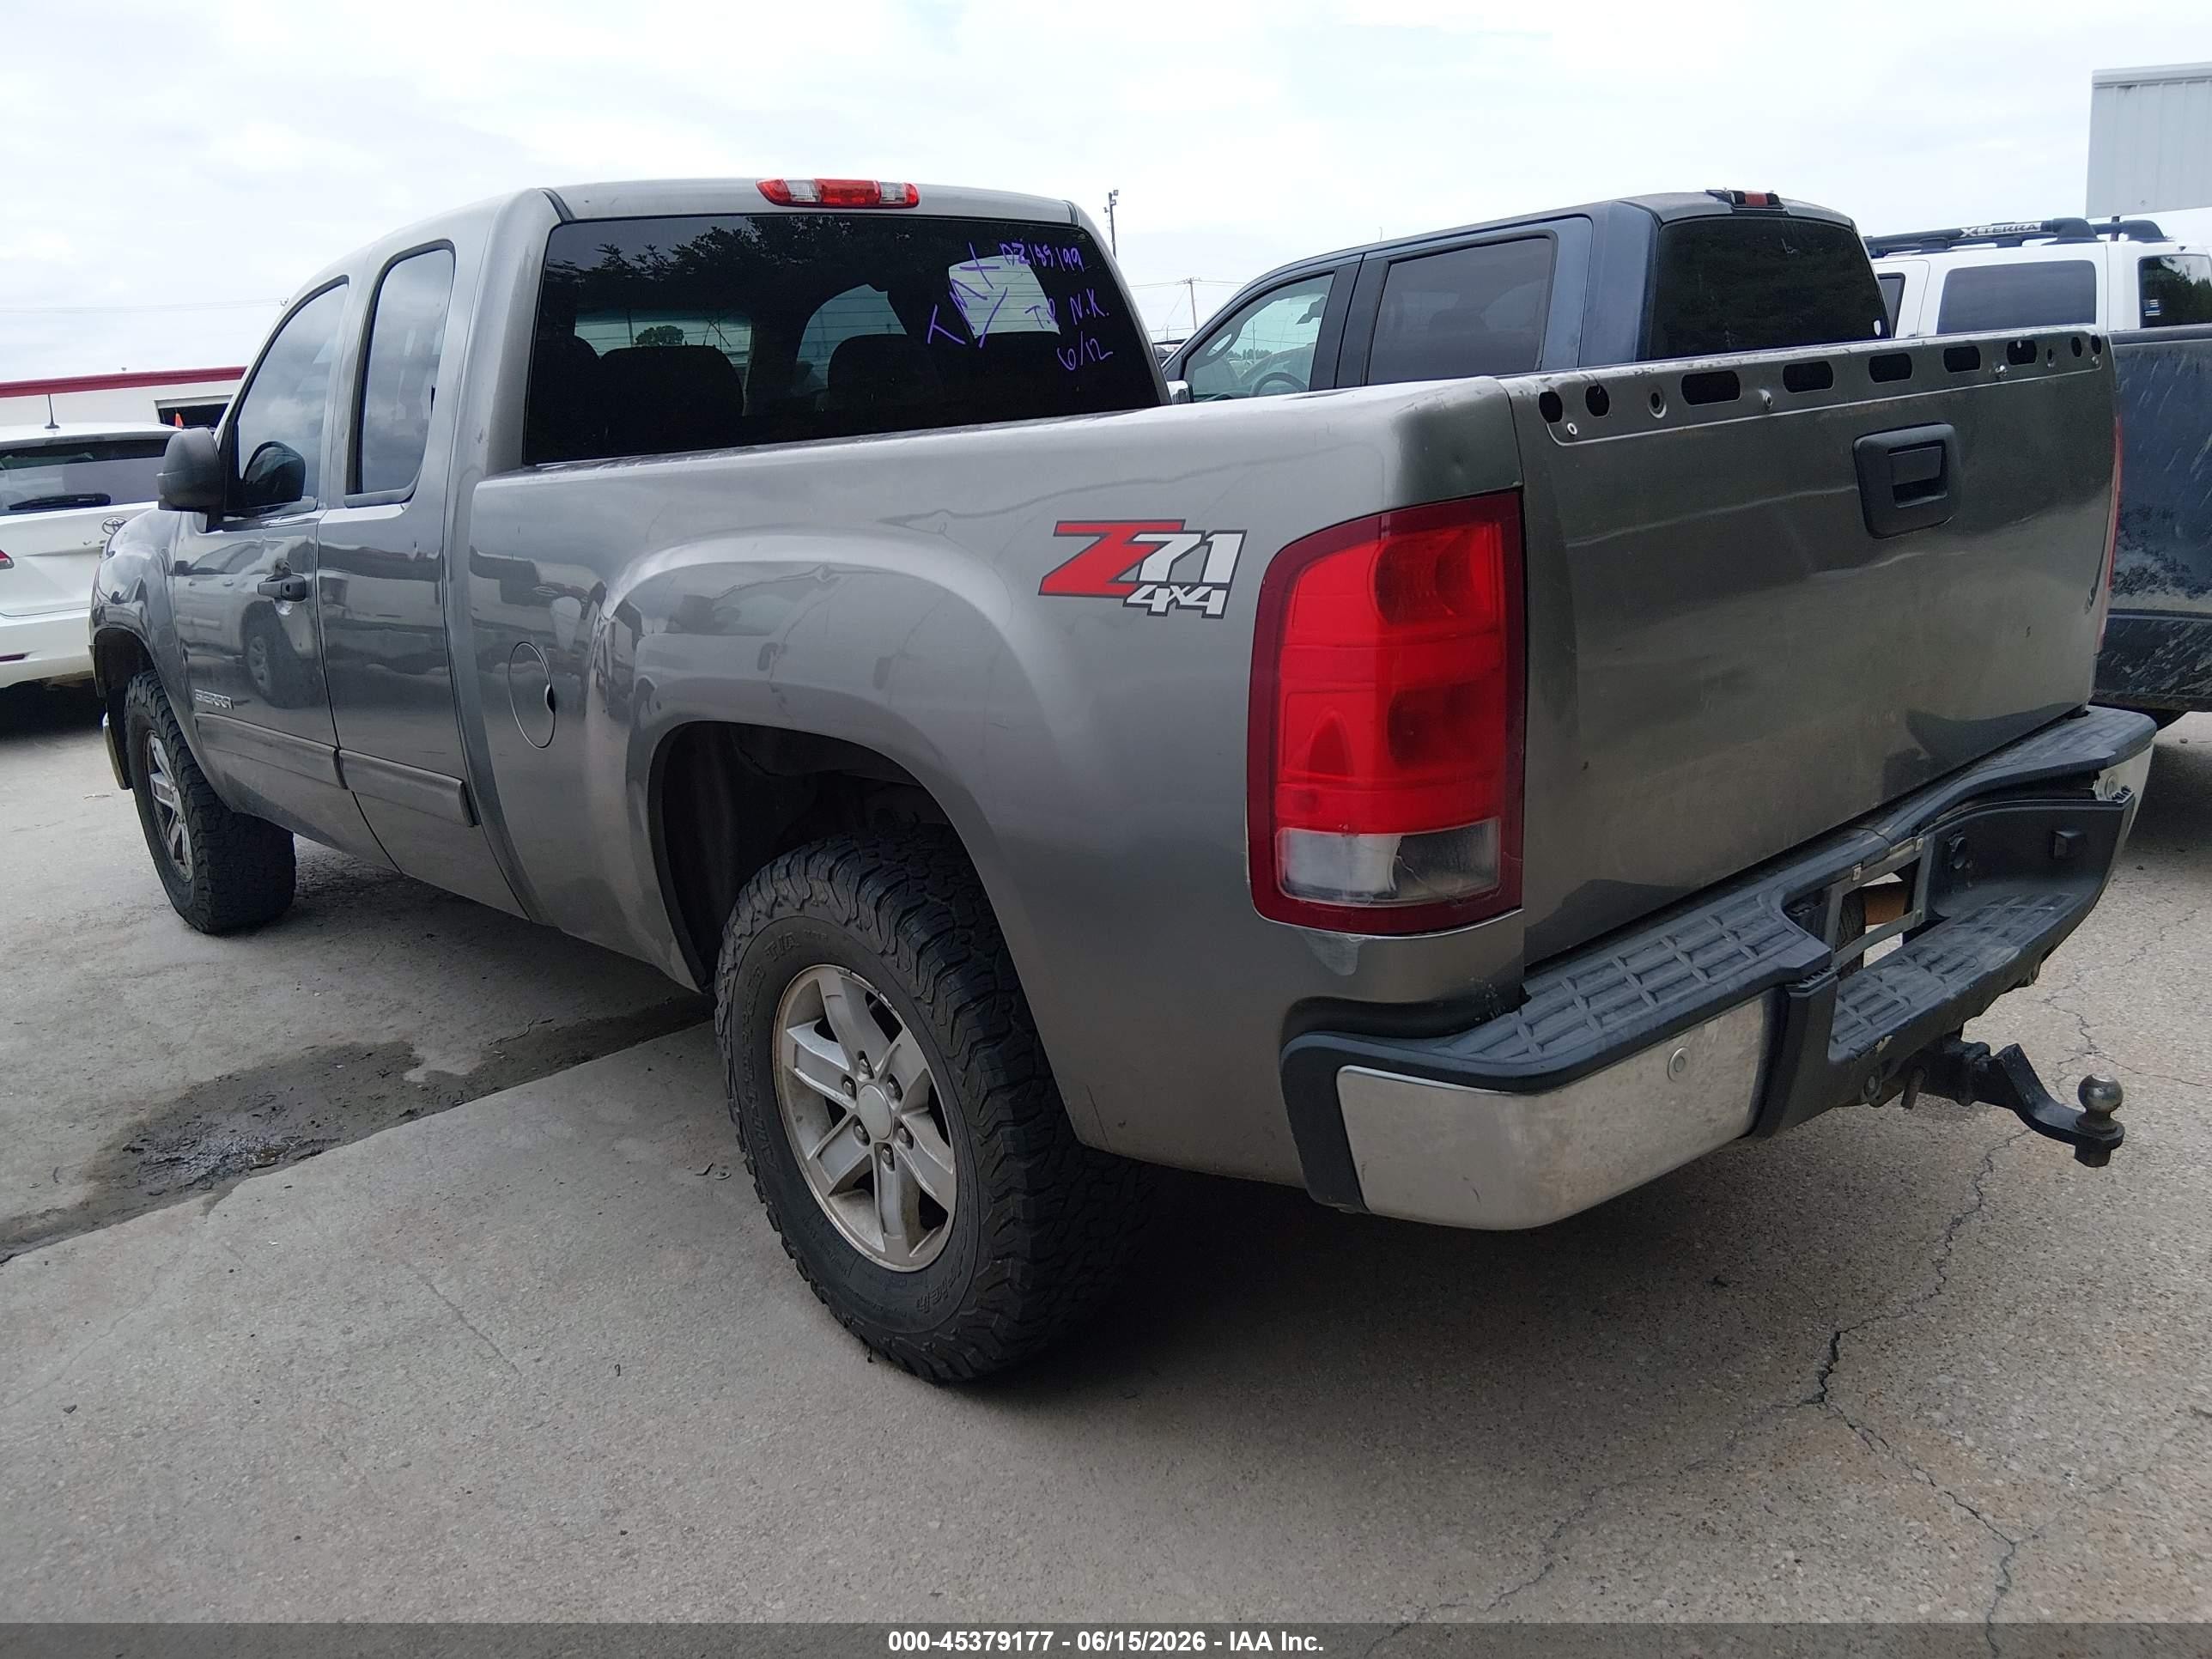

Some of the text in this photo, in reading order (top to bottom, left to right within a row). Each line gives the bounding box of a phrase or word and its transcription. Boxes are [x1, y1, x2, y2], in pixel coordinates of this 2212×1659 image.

[1960, 223, 2039, 238] XTERRA
[1057, 331, 1114, 371] 6/12
[1038, 519, 1247, 598] Z71
